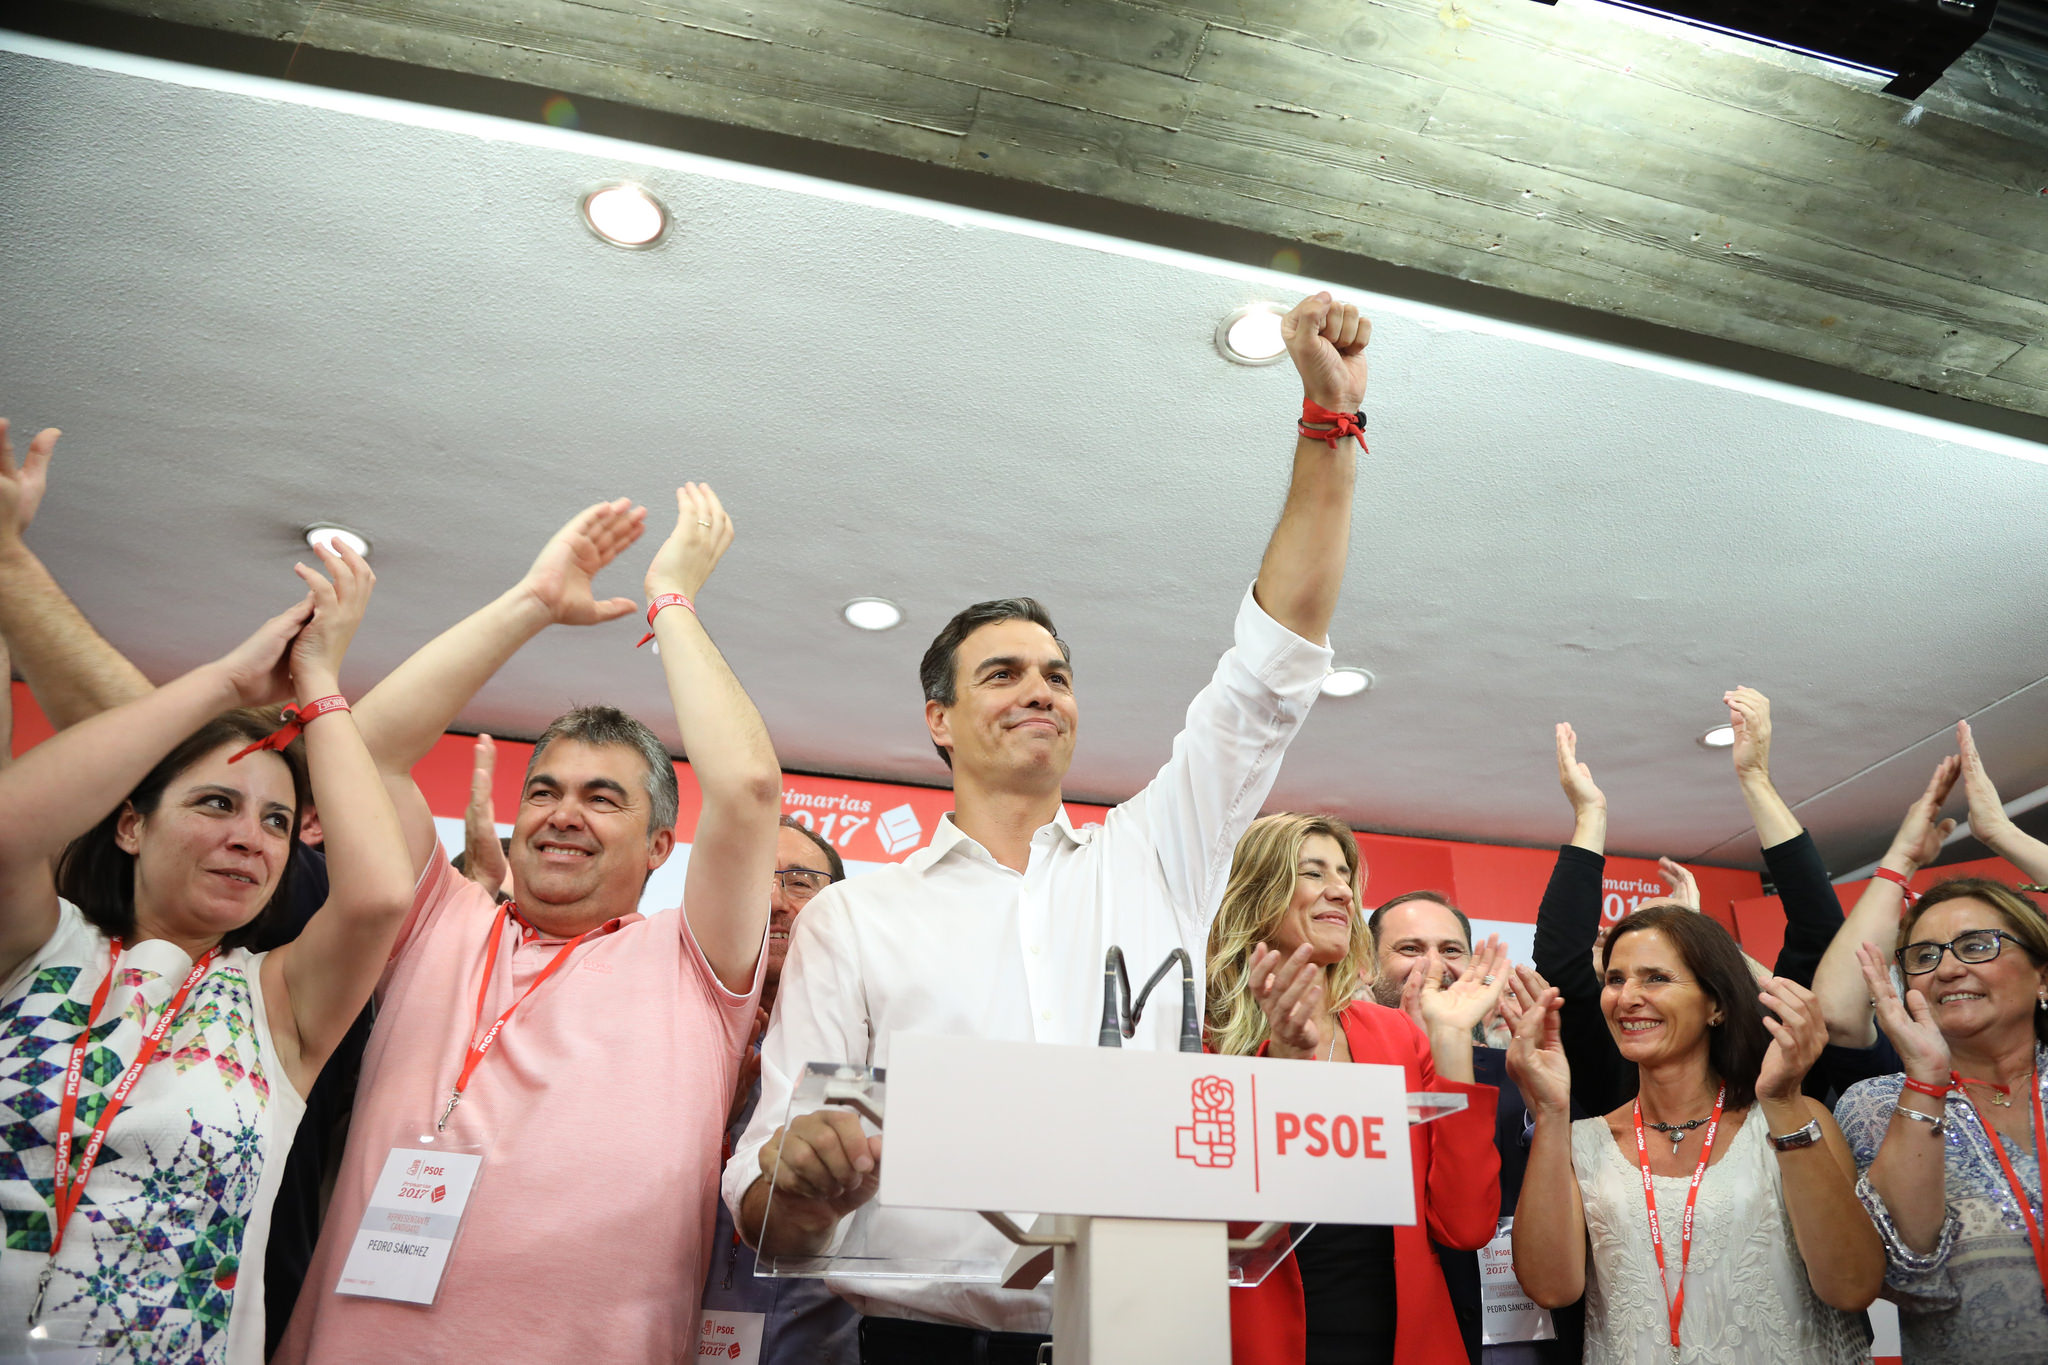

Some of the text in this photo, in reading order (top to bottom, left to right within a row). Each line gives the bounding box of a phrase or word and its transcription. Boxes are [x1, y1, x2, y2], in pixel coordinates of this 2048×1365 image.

[782, 788, 871, 812] imarias
[789, 809, 870, 847] 017
[1602, 879, 1660, 894] marias
[183, 964, 205, 990] PSOE
[151, 1008, 176, 1041] PSOE
[479, 1019, 504, 1053] PSOE
[66, 1048, 83, 1096] PSOE
[115, 1063, 143, 1100] PSOE
[1275, 1112, 1387, 1159] PSOE
[1704, 1121, 1717, 1147] PSOE
[56, 1131, 71, 1187] PSOE
[76, 1129, 105, 1184] PSOE
[424, 1166, 445, 1176] PSOE
[1642, 1165, 1652, 1190] PSOE
[1691, 1162, 1705, 1187] PSOE
[398, 1187, 429, 1199] 2017
[1649, 1209, 1660, 1245] PSOE
[1684, 1205, 1693, 1241] PSOE
[367, 1239, 430, 1258] PEDRO SÁNCHEZ
[1486, 1267, 1508, 1275] 2017
[1487, 1304, 1506, 1313] PEDRO
[716, 1326, 735, 1334] PSOE
[698, 1345, 726, 1356] 2017
